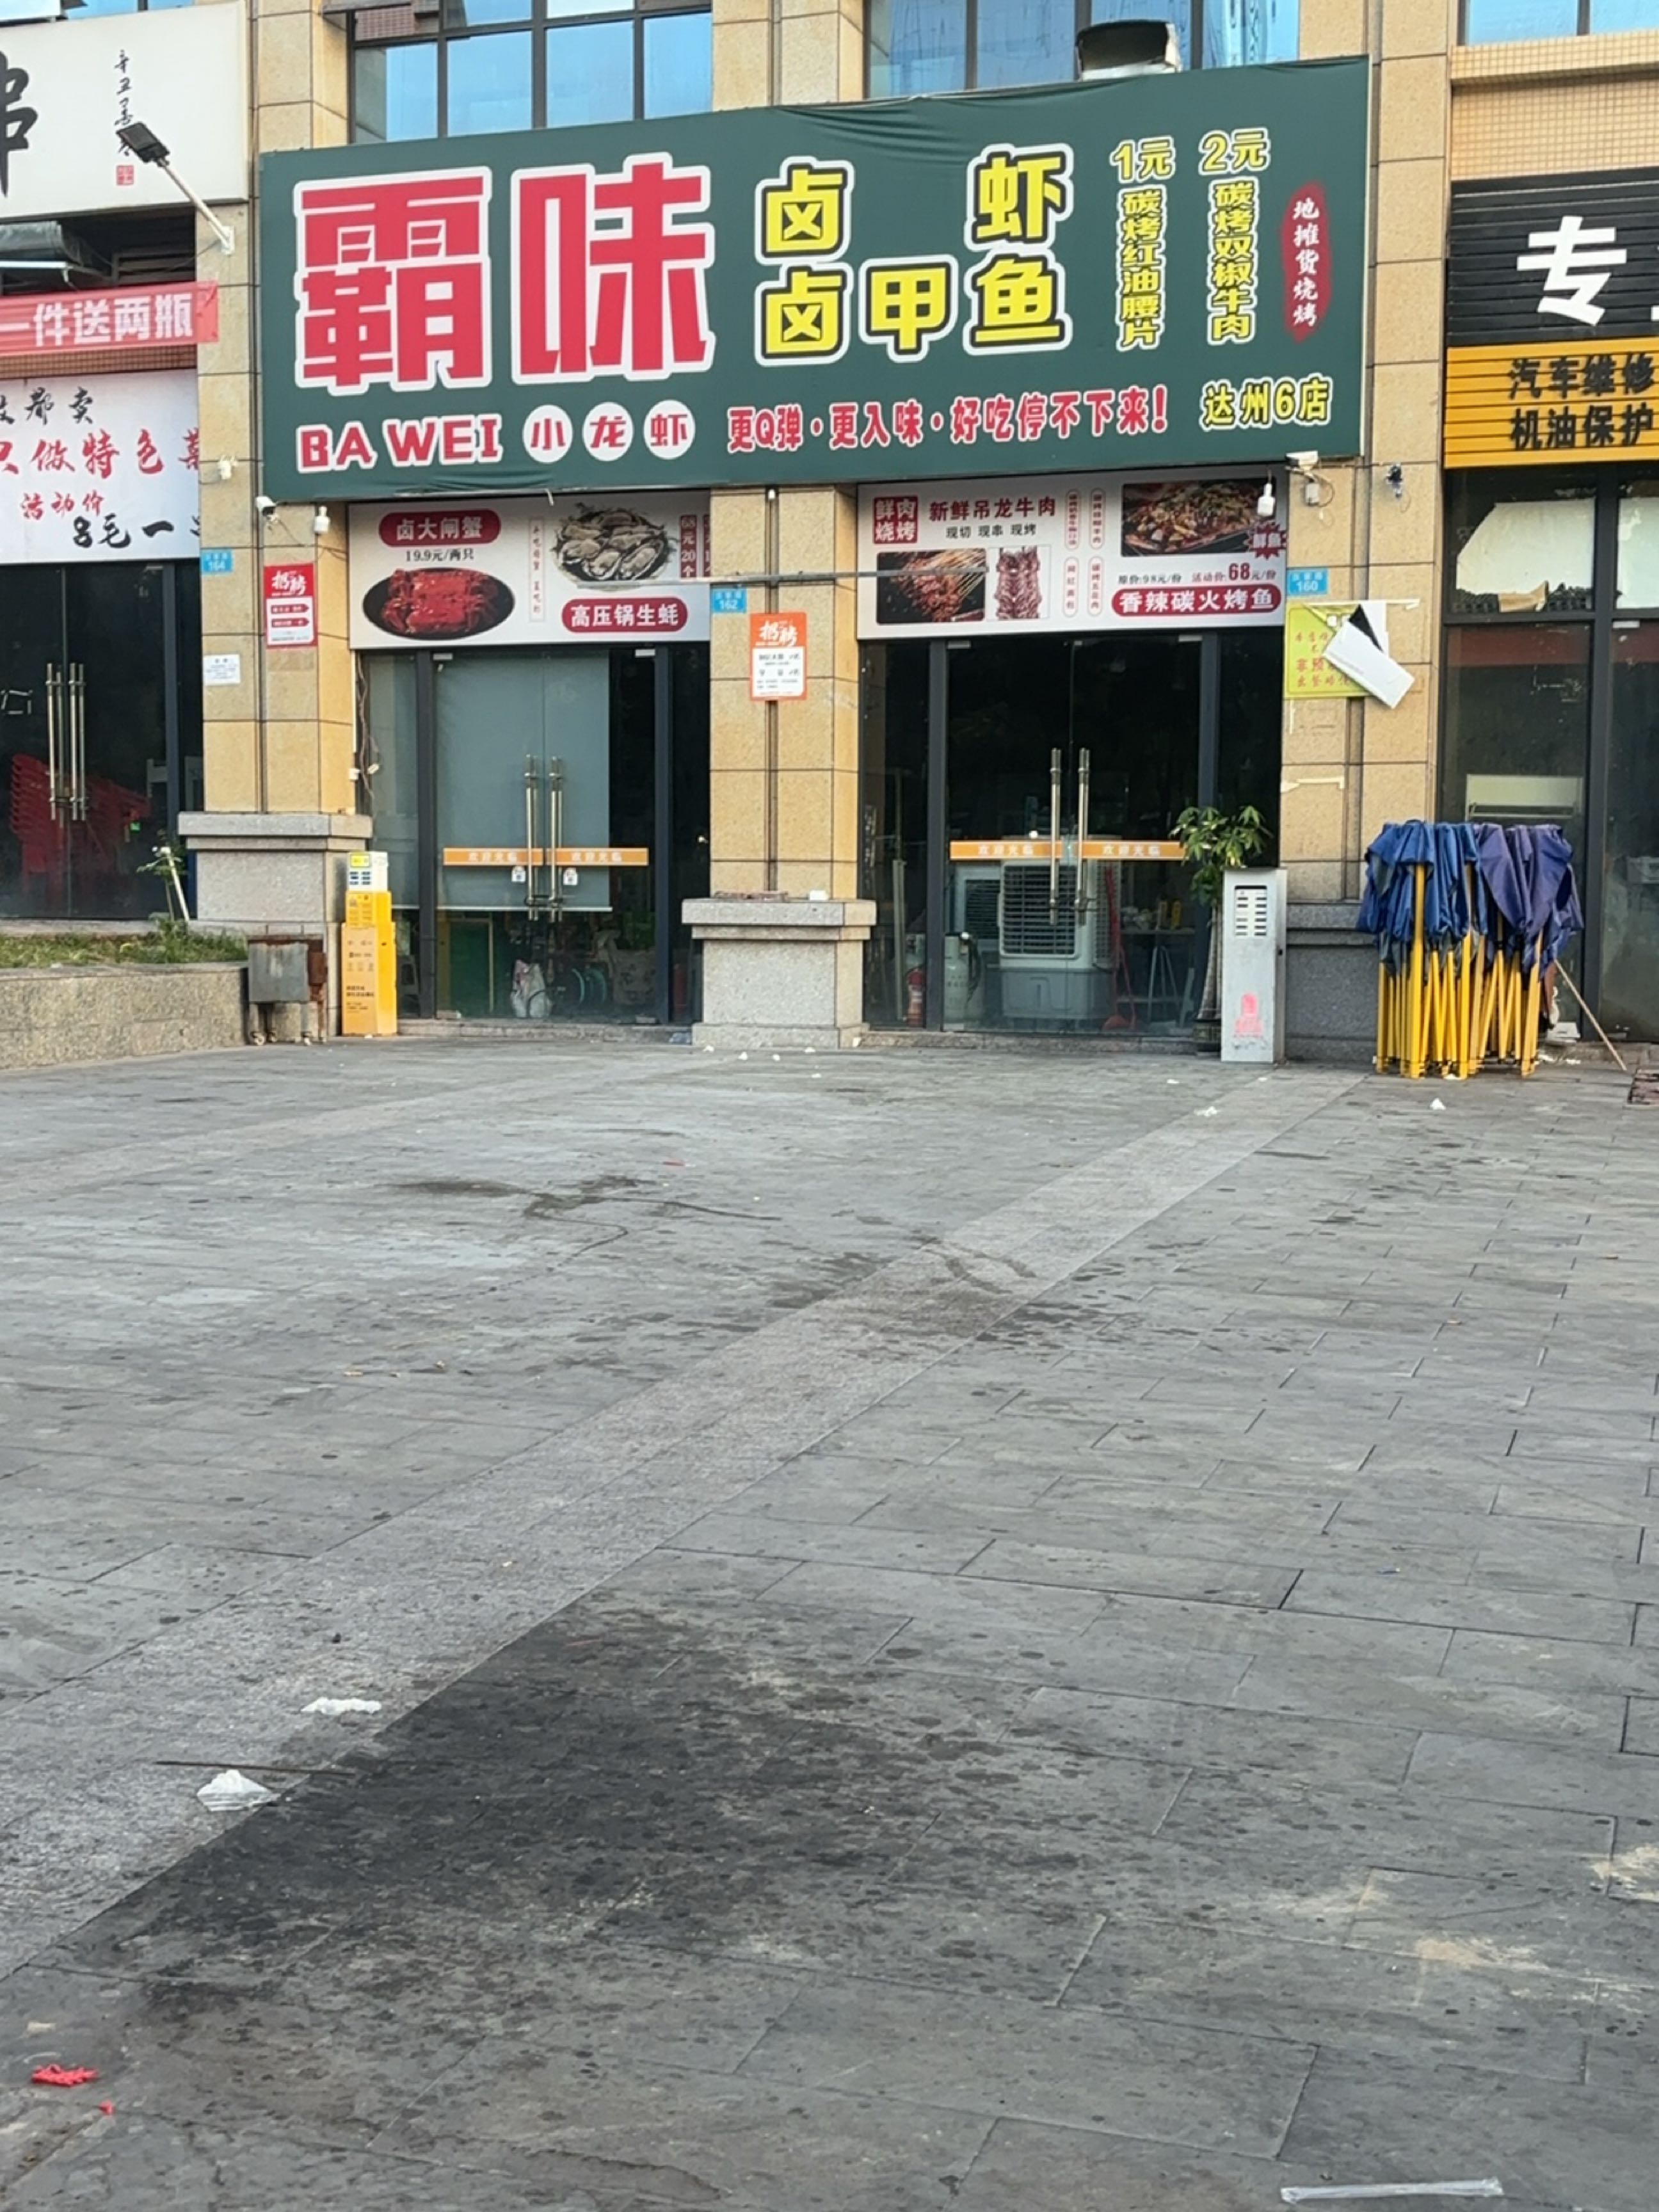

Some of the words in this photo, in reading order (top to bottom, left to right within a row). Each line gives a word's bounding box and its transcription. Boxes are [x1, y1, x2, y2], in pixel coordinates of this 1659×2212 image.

[1110, 136, 1174, 183] 1元
[1199, 127, 1270, 175] 2元
[755, 156, 854, 266] 卤
[964, 143, 1074, 250] 虾
[294, 151, 716, 396] 霸味
[1116, 184, 1166, 351] 碳烤红油腰片
[1207, 176, 1258, 344] 碳烤双椒牛肉
[1516, 216, 1659, 326] 专
[755, 247, 1072, 367] 卤甲鱼
[1508, 351, 1655, 399] 汽车维修
[1199, 372, 1331, 431] 达州6店
[529, 412, 689, 451] 小龙虾
[1510, 402, 1653, 450] 机油保护
[396, 516, 483, 541] 卤大闸蟹
[929, 495, 1057, 522] 新鲜吊龙牛肉
[570, 603, 679, 627] 高压锅生蚝
[1119, 588, 1274, 614] 香辣碳火烤鱼
